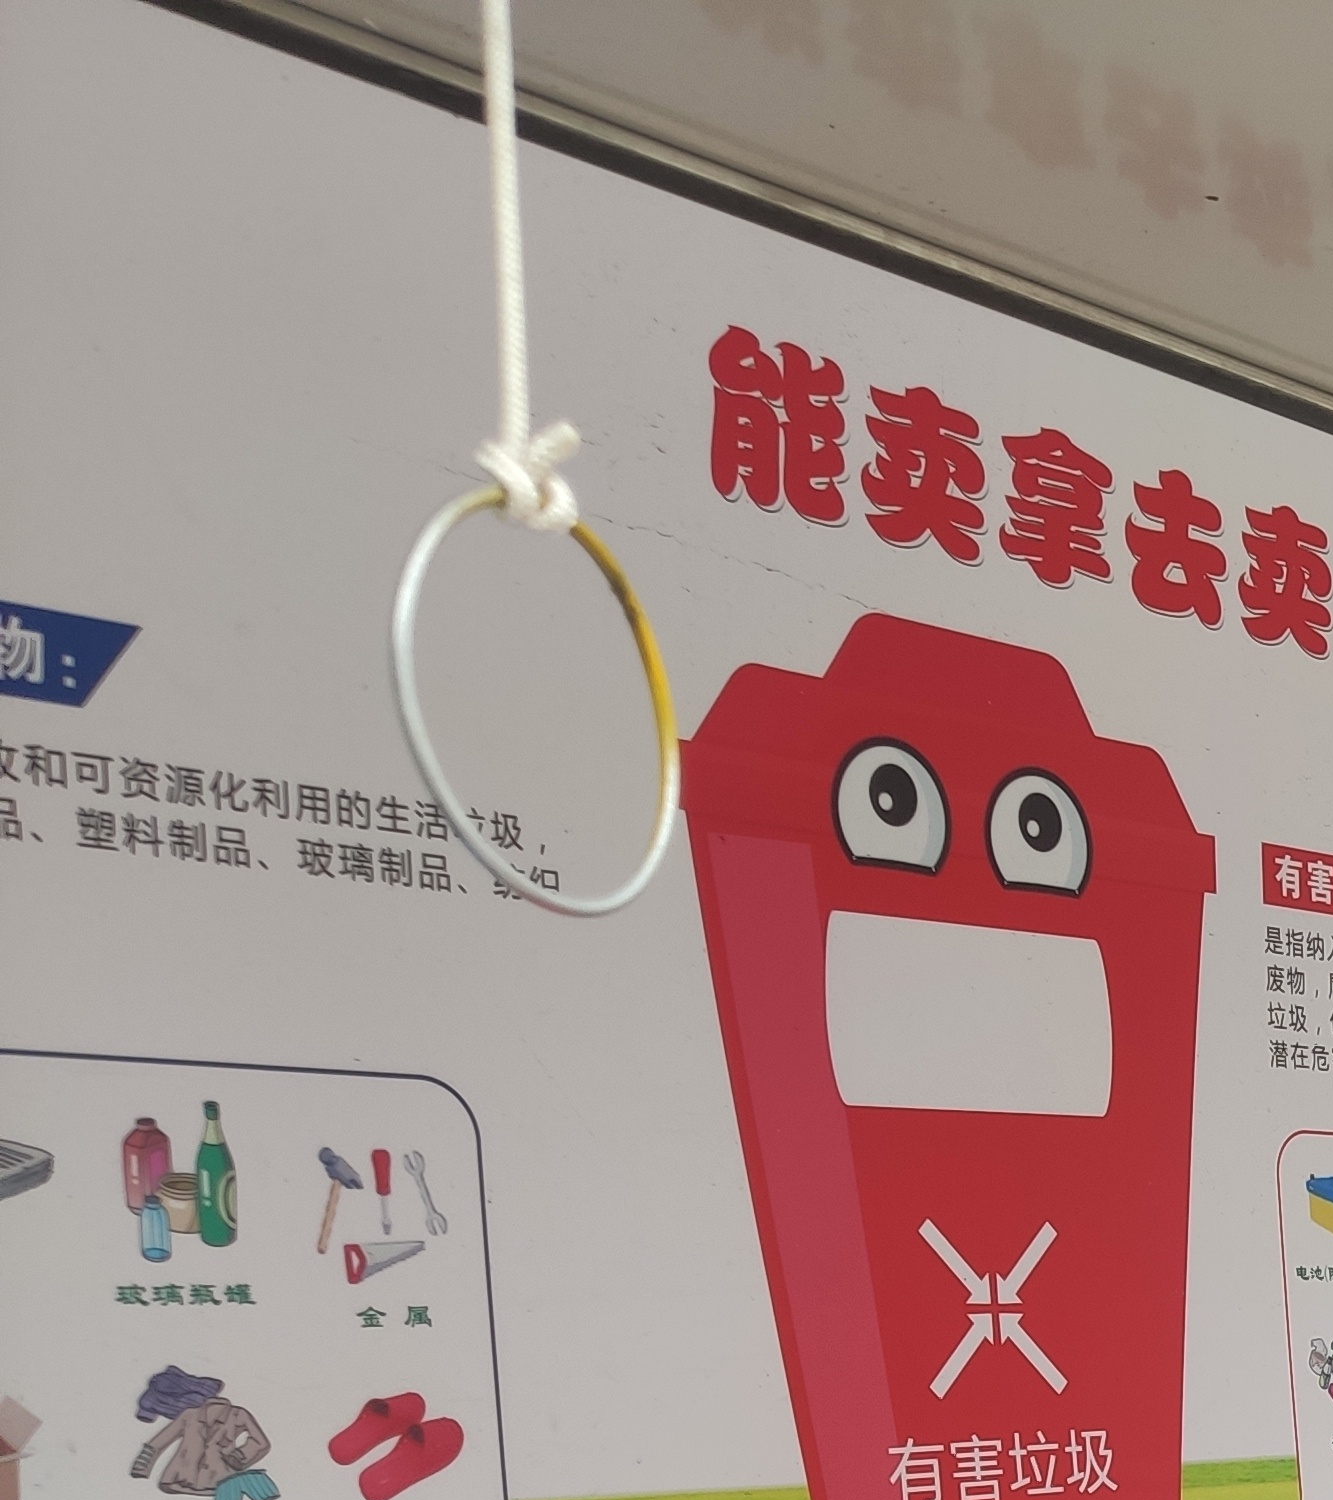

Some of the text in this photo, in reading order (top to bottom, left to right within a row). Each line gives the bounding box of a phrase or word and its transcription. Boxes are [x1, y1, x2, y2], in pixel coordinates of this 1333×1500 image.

[114, 1283, 258, 1308] 玻璃瓶罐
[356, 1305, 433, 1329] 金属
